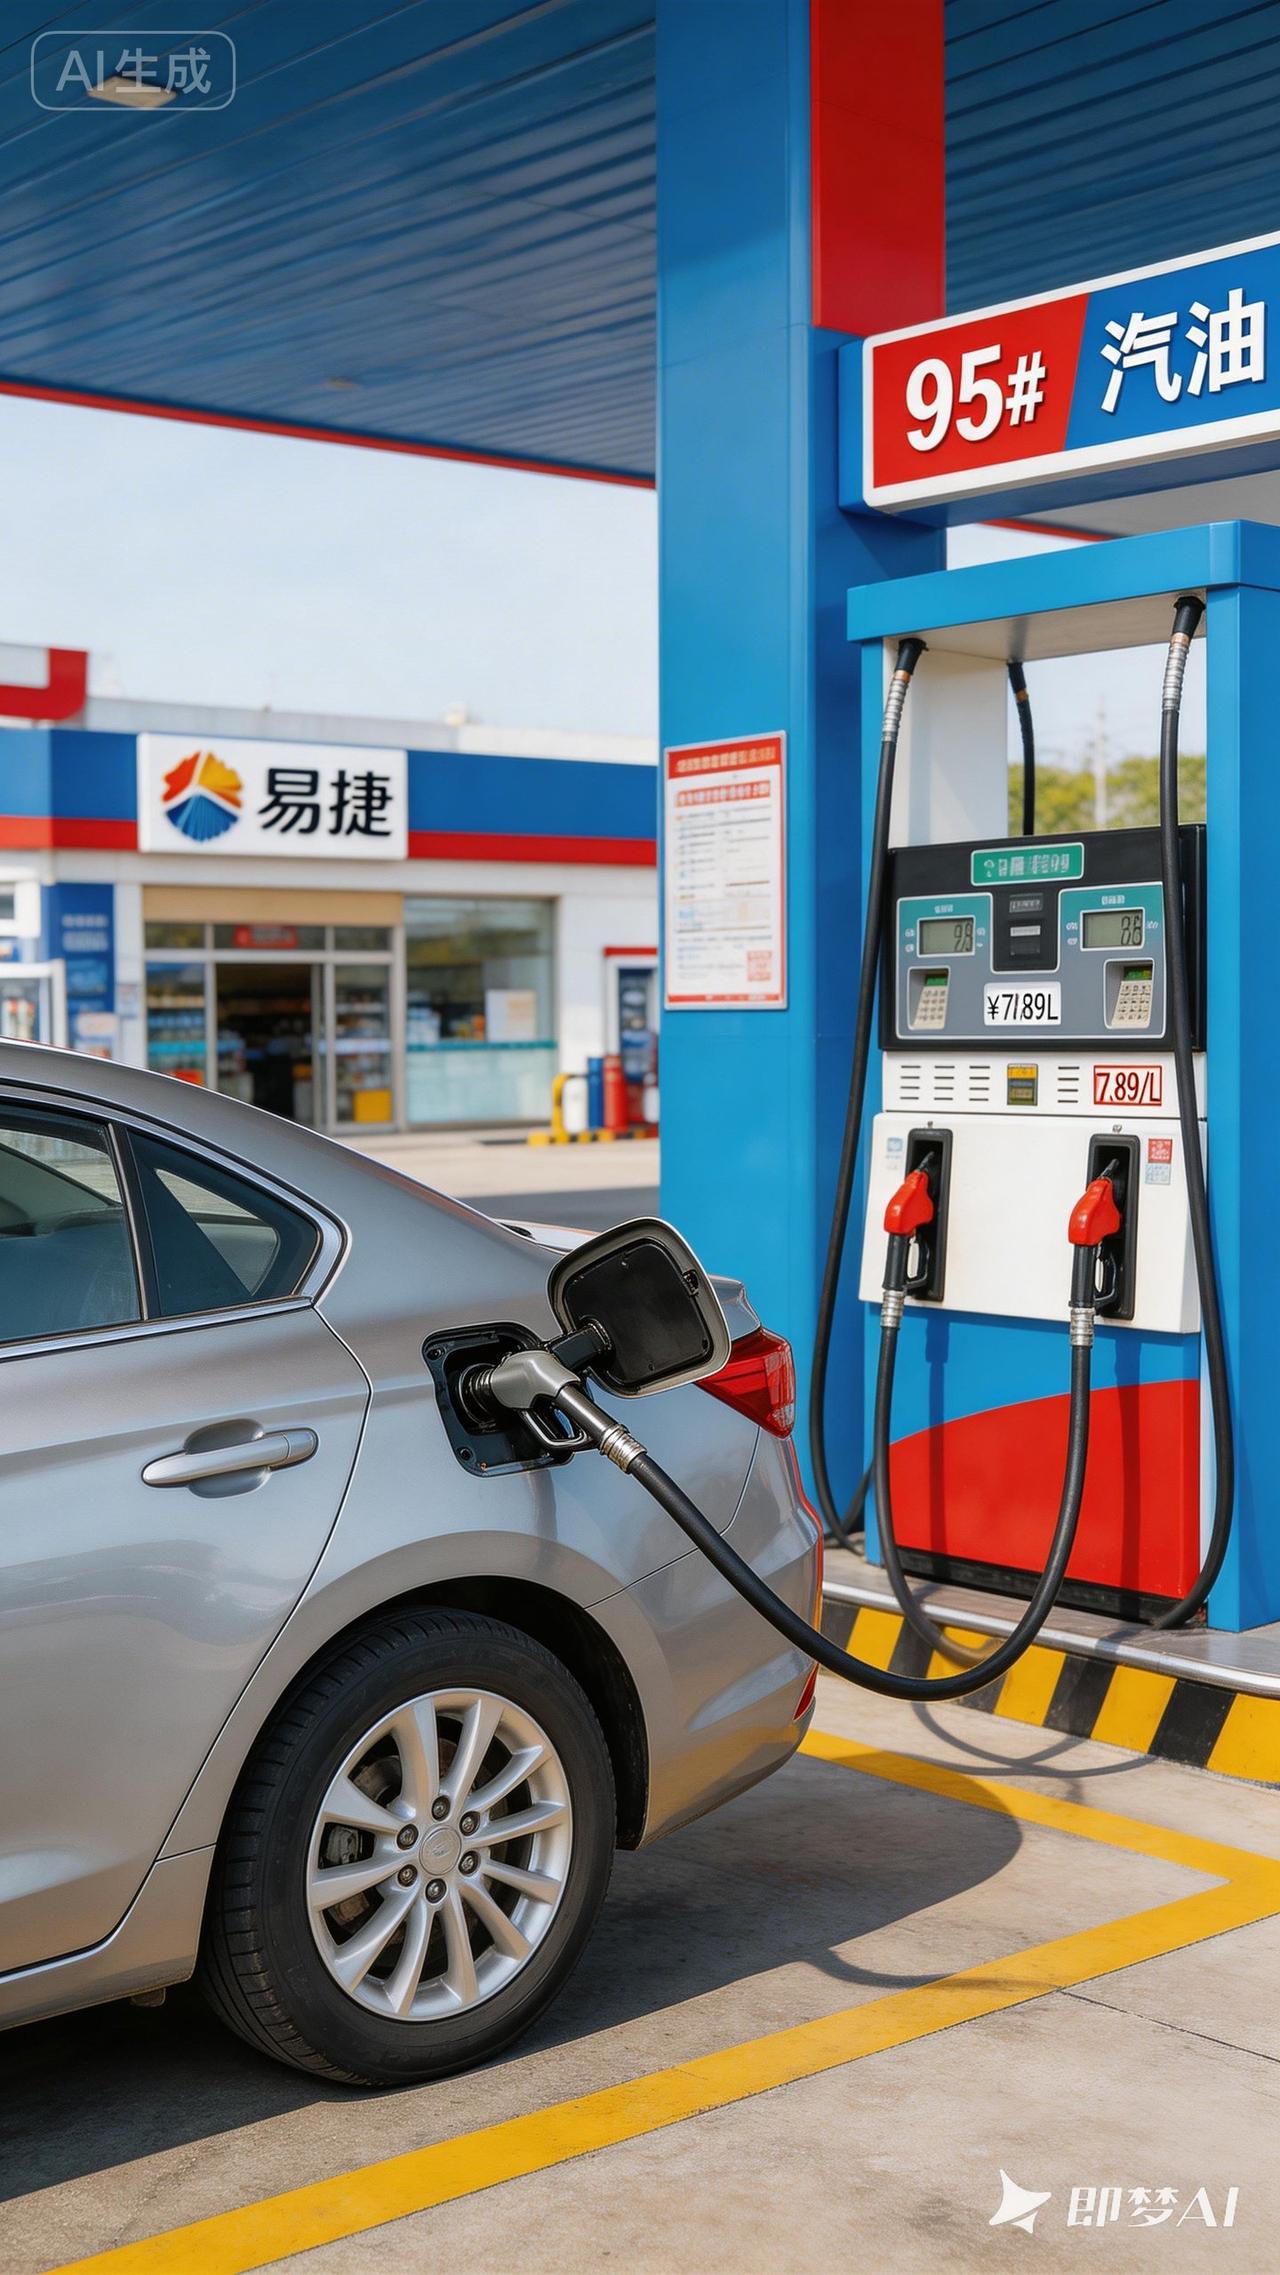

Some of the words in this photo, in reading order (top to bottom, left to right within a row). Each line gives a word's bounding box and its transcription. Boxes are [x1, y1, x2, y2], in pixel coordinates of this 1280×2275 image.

[905, 343, 1047, 452] 95#
[1100, 287, 1265, 413] 汽油
[257, 768, 393, 836] 易捷
